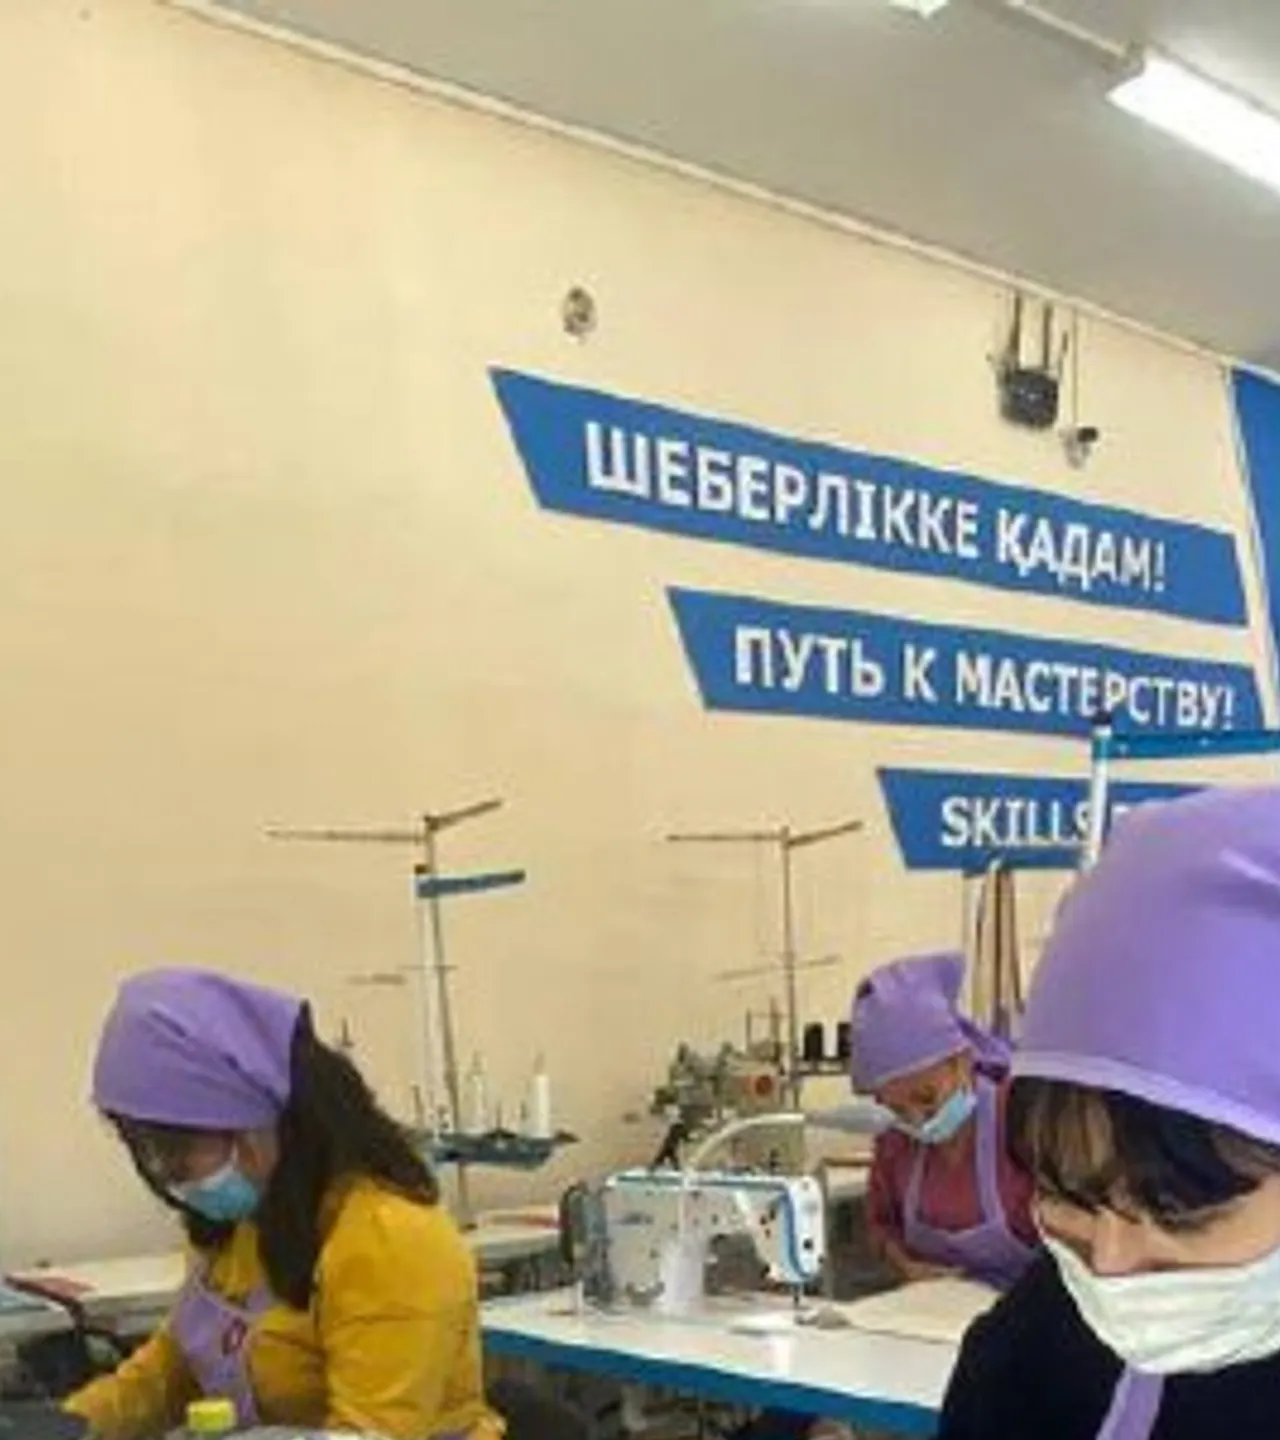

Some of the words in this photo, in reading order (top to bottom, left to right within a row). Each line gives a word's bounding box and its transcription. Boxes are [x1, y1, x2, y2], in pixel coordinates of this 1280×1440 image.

[585, 421, 981, 561] ШЕБЕРЛІККЕ
[997, 508, 1166, 593] ҚАДАМ!
[735, 624, 886, 698] ПУТЬ
[903, 643, 938, 704] К
[954, 650, 1234, 732] МАСТЕРСТВУ!
